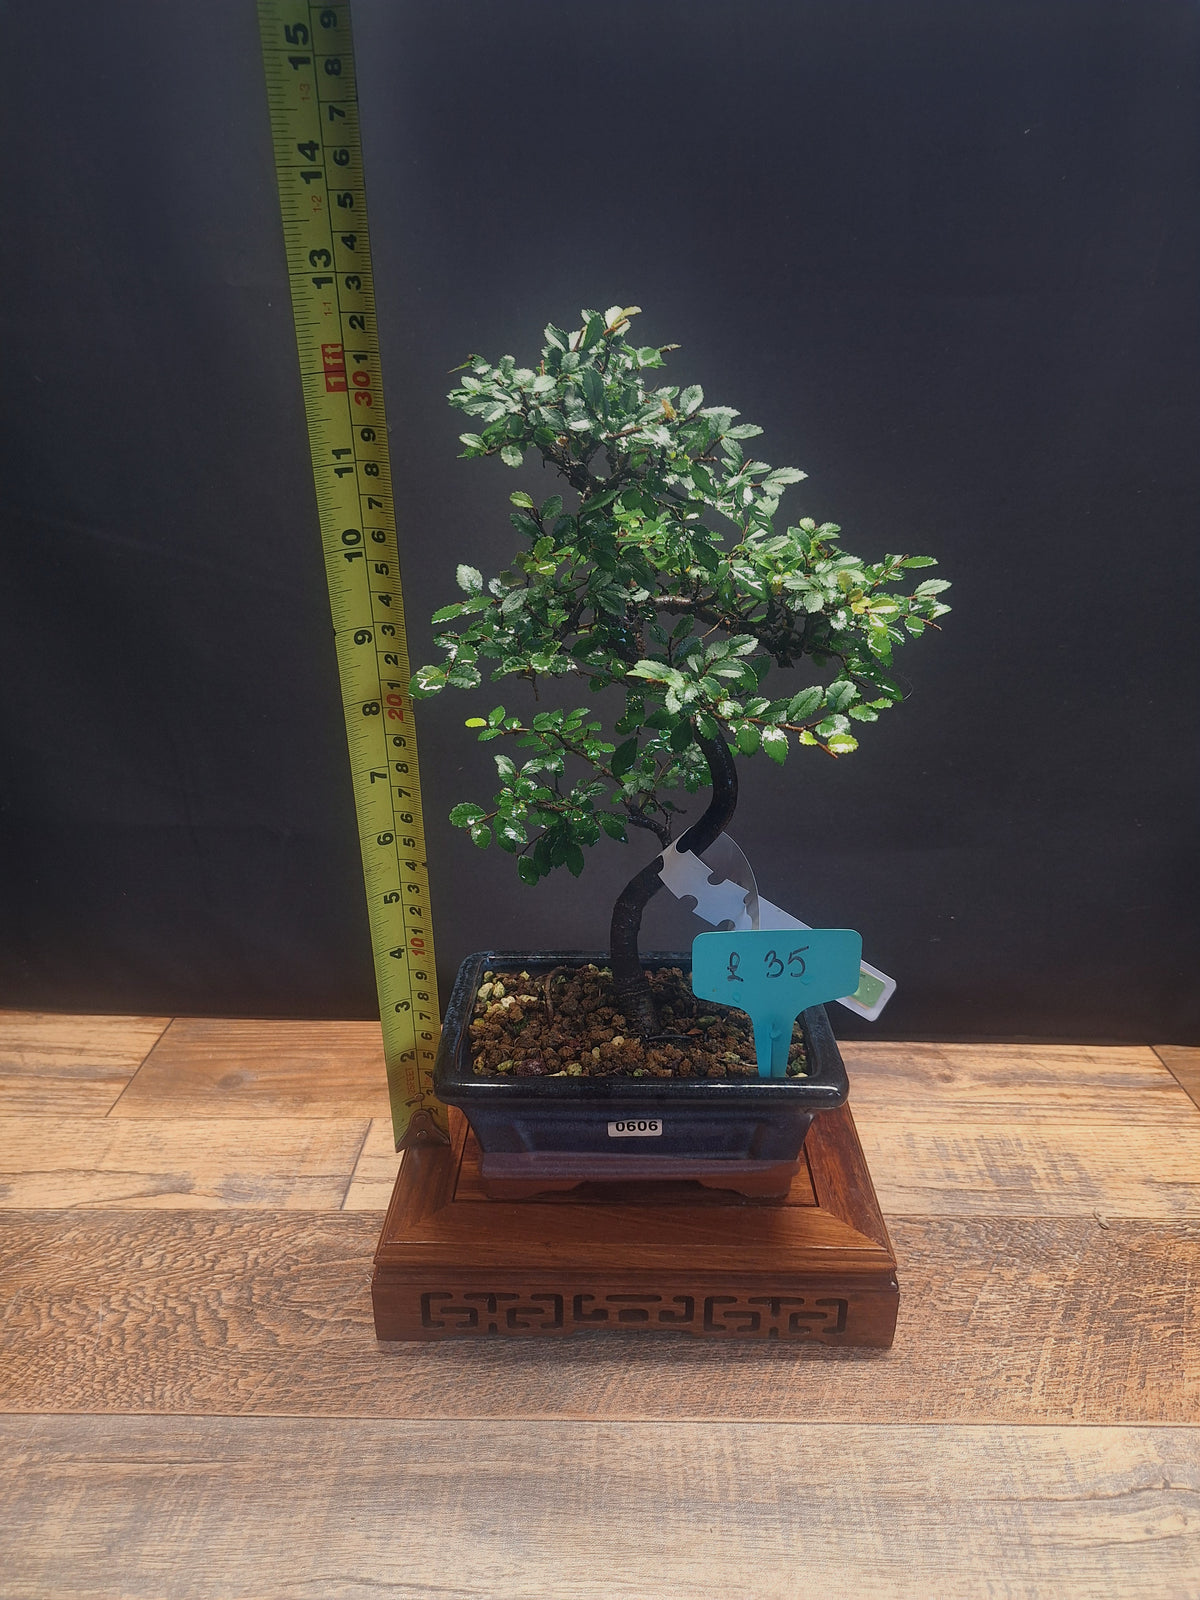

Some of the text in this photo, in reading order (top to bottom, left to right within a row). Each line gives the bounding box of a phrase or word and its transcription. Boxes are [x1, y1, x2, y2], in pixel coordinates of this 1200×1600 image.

[320, 9, 337, 29] 9
[284, 22, 311, 71] 15
[324, 58, 342, 76] 8
[328, 105, 346, 121] 7
[297, 140, 322, 185] 14
[333, 149, 350, 166] 6
[337, 192, 354, 209] 5
[341, 234, 357, 250] 4
[309, 248, 334, 290] 13
[345, 275, 362, 290] 3
[349, 315, 365, 331] 2
[353, 354, 368, 363] 1
[352, 371, 373, 408] 30
[360, 428, 376, 442] 9
[331, 448, 354, 478] 11
[364, 463, 380, 477] 8
[367, 497, 383, 509] 7
[371, 531, 386, 543] 6
[341, 529, 363, 562] 10
[375, 563, 390, 575] 5
[378, 594, 392, 607] 4
[381, 624, 396, 637] 3
[353, 629, 373, 646] 9
[384, 654, 399, 666] 2
[387, 682, 400, 690] 1
[362, 702, 380, 716] 8
[386, 694, 404, 722] 20
[392, 736, 407, 748] 9
[395, 762, 409, 774] 8
[370, 771, 387, 784] 7
[398, 788, 411, 798] 7
[400, 813, 414, 824] 6
[377, 832, 394, 846] 6
[403, 838, 416, 848] 5
[405, 861, 418, 872] 4
[407, 884, 420, 894] 3
[383, 892, 400, 905] 5
[409, 906, 422, 917] 2
[410, 937, 426, 957] 10
[389, 948, 405, 960] 4
[764, 946, 810, 978] 35
[415, 971, 428, 981] 9
[417, 992, 430, 1001] 8
[394, 1001, 411, 1013] 3
[419, 1012, 432, 1021] 7
[421, 1032, 433, 1041] 6
[400, 1051, 416, 1063] 2
[422, 1051, 435, 1060] 5
[616, 1121, 658, 1132] 0606
